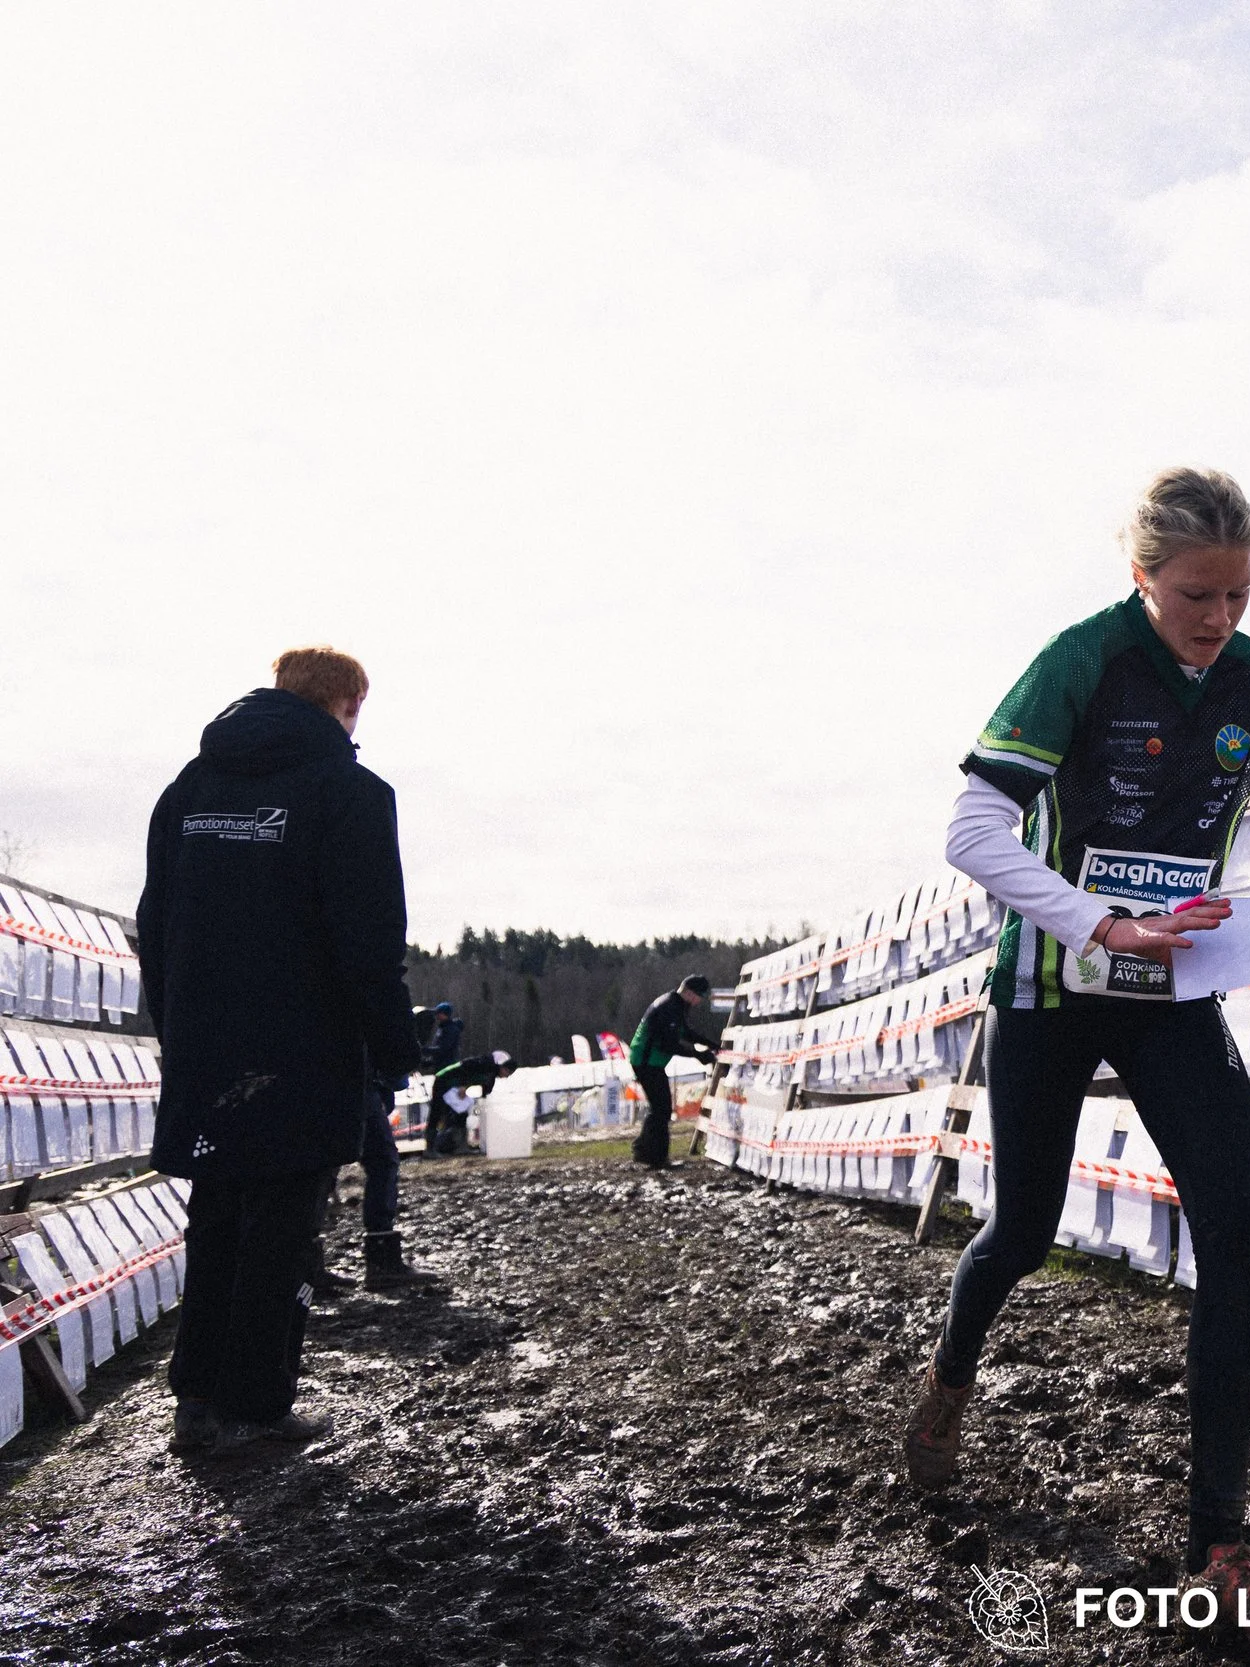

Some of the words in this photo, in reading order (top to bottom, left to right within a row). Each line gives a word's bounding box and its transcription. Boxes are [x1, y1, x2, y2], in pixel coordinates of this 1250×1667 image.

[1111, 720, 1160, 729] noname
[1115, 781, 1140, 791] Sture
[1119, 789, 1155, 797] Persson
[183, 817, 255, 832] Promotionhuset
[1088, 857, 1207, 888] bagheera
[1097, 884, 1166, 901] KOLMÅRDSKAVLEN
[1116, 960, 1167, 972] GODKÄNDA
